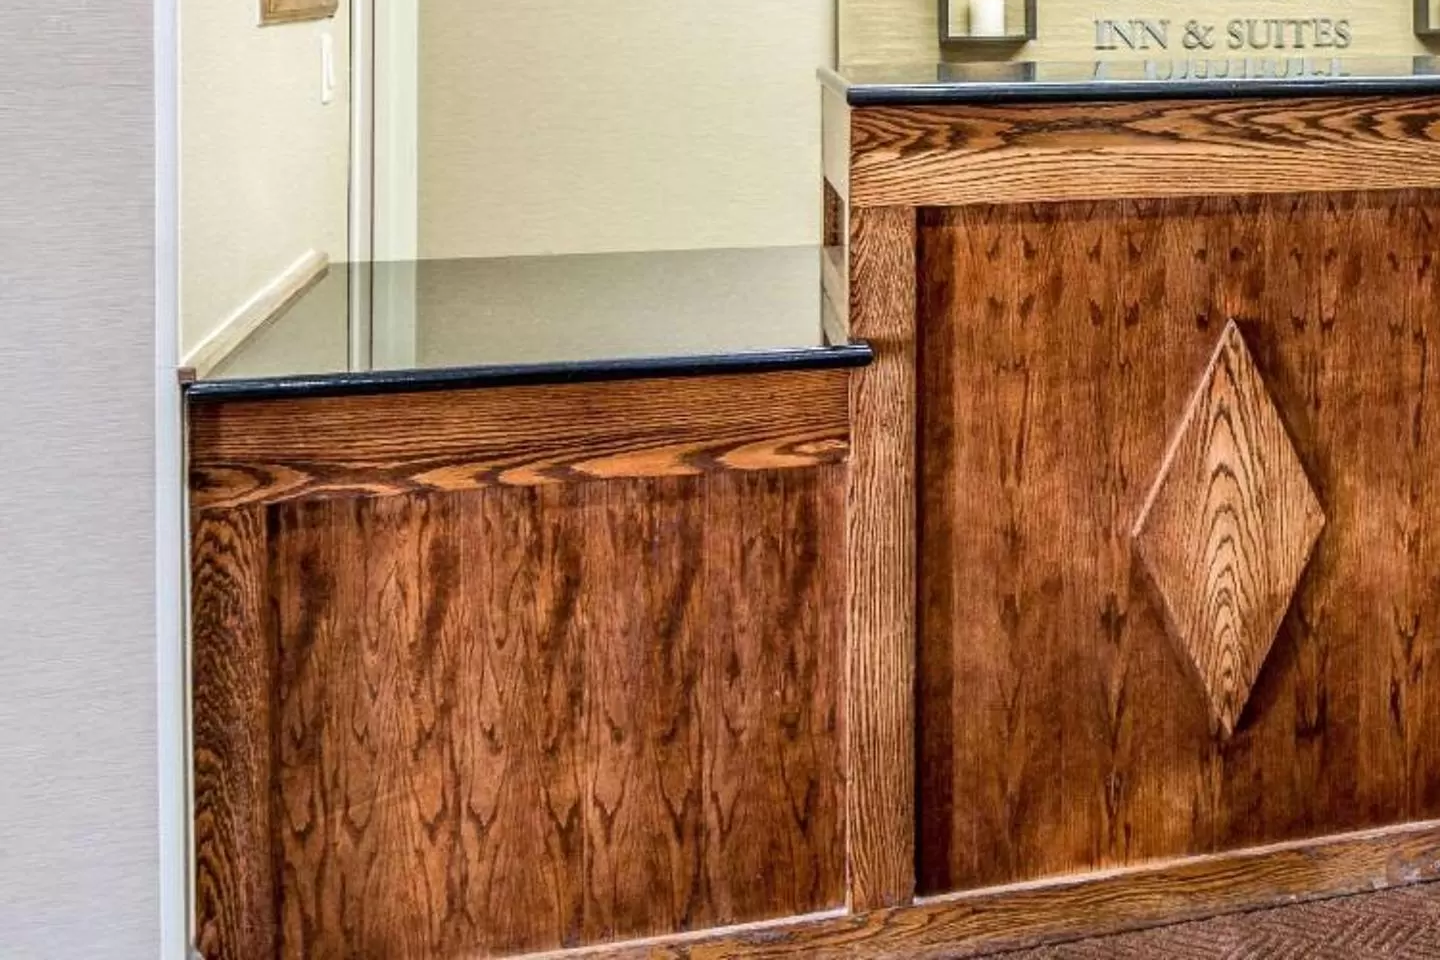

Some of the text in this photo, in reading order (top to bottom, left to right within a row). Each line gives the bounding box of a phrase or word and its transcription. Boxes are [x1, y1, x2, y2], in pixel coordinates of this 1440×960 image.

[1094, 18, 1352, 50] INN & SUITES
